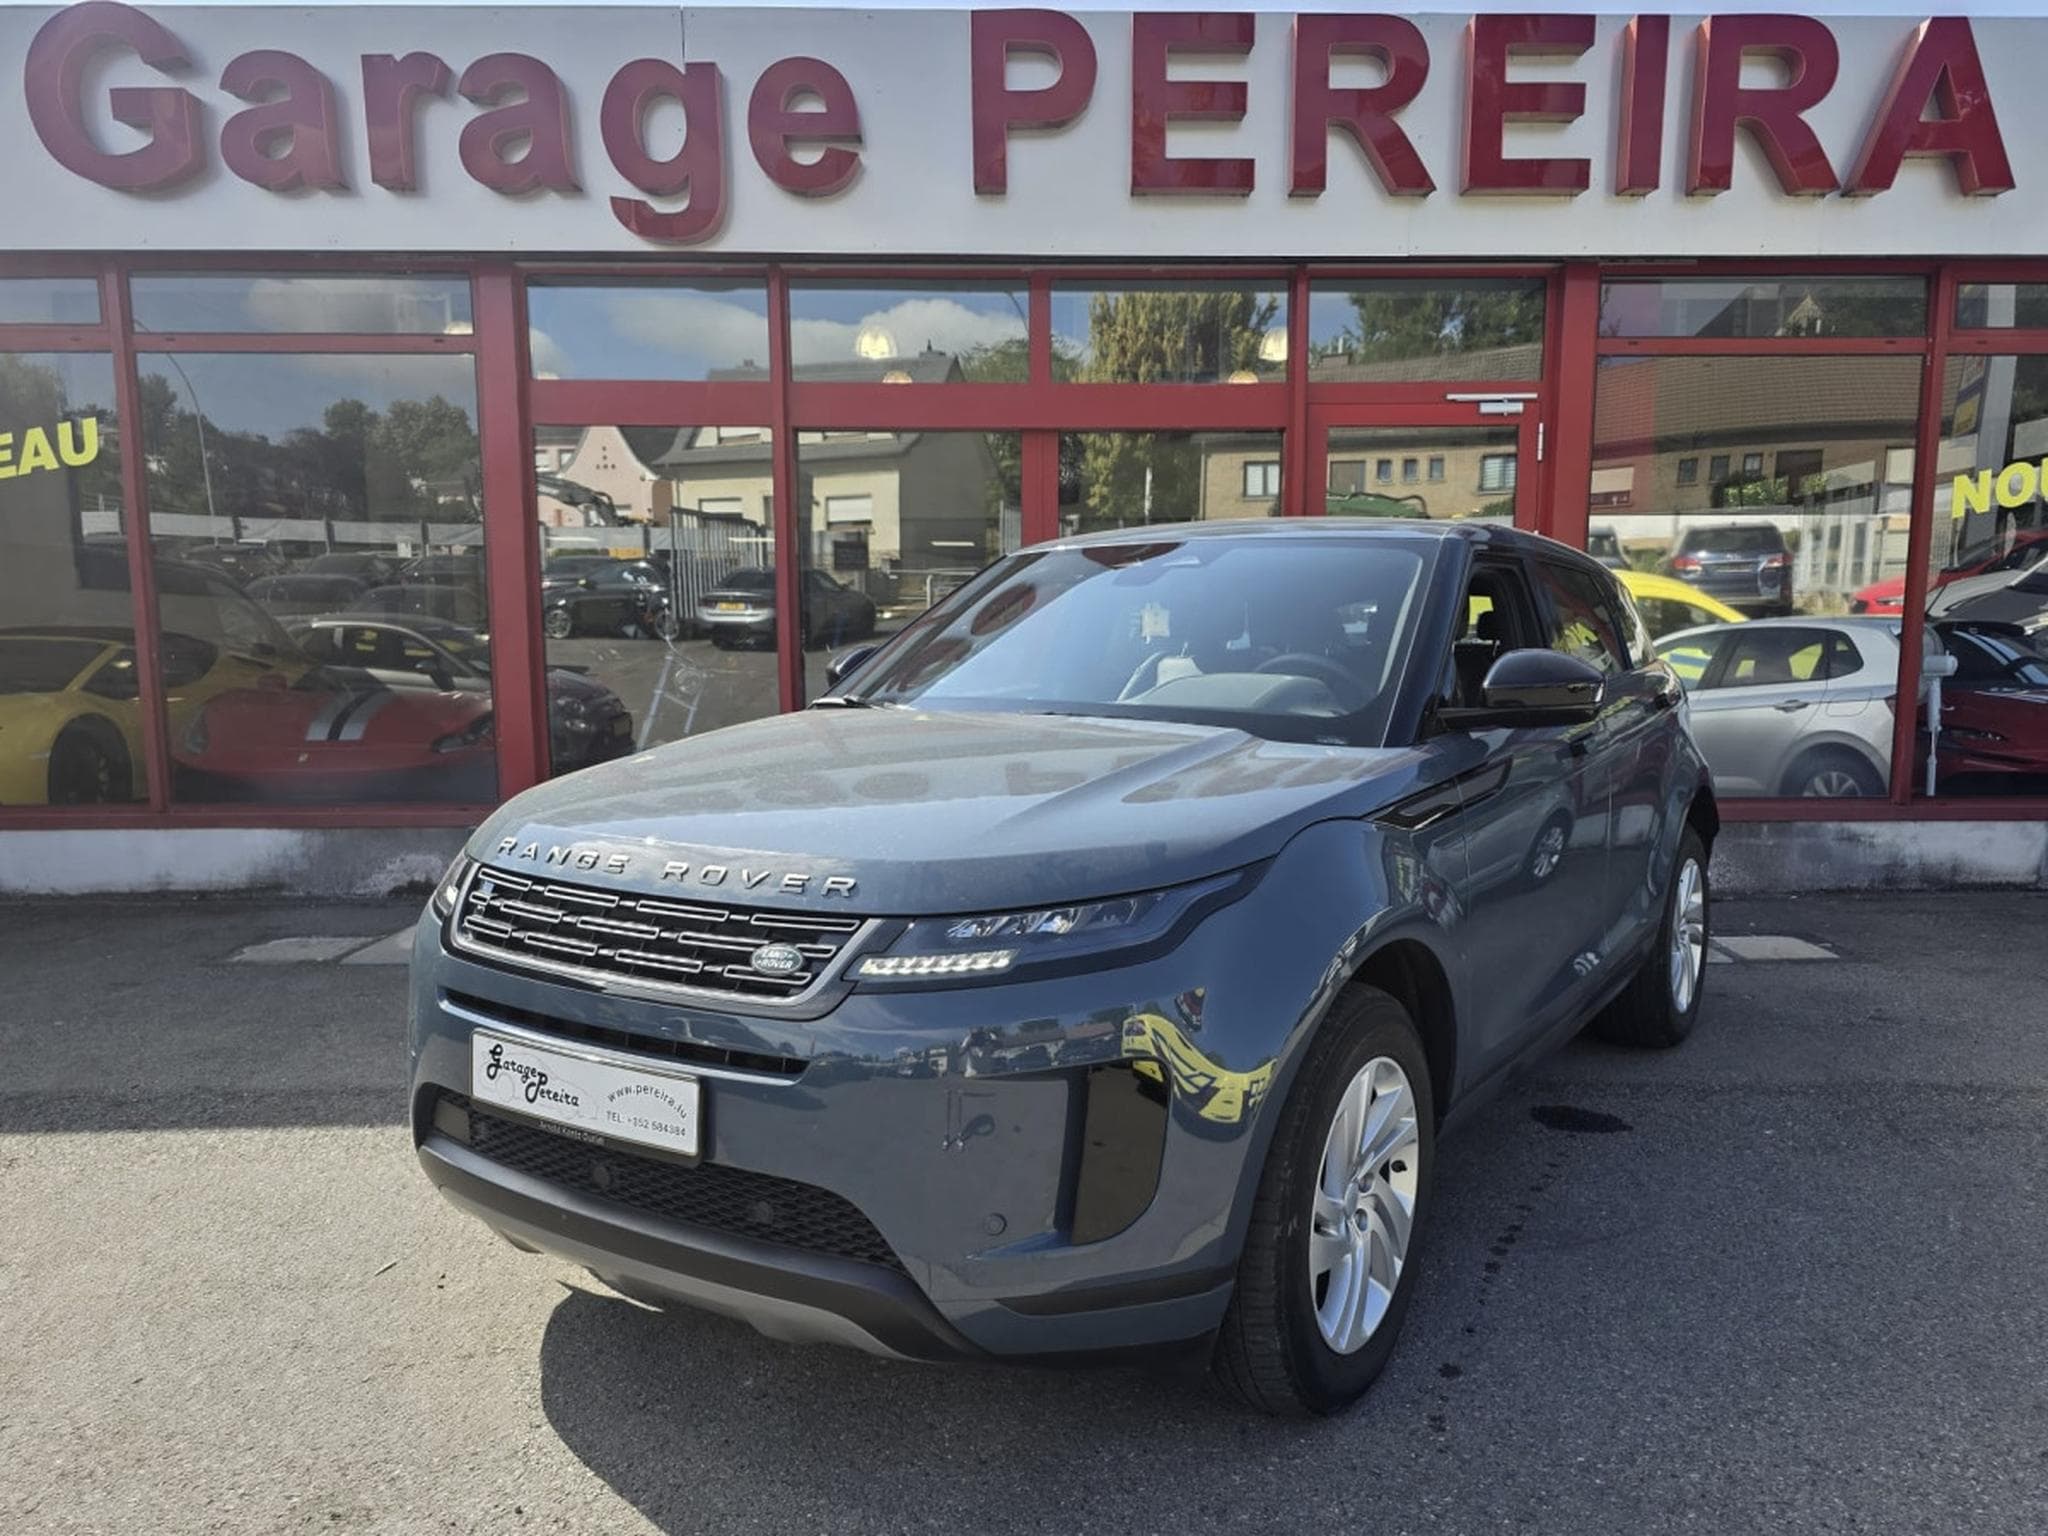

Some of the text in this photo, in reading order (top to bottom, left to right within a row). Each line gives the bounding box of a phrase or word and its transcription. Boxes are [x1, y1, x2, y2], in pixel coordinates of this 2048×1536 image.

[23, 1, 2018, 245] Garage PEREIRA
[1952, 457, 2048, 519] NO
[497, 836, 859, 898] RANGE ROVER
[486, 1043, 538, 1084] Garage
[525, 1071, 580, 1107] Pereira
